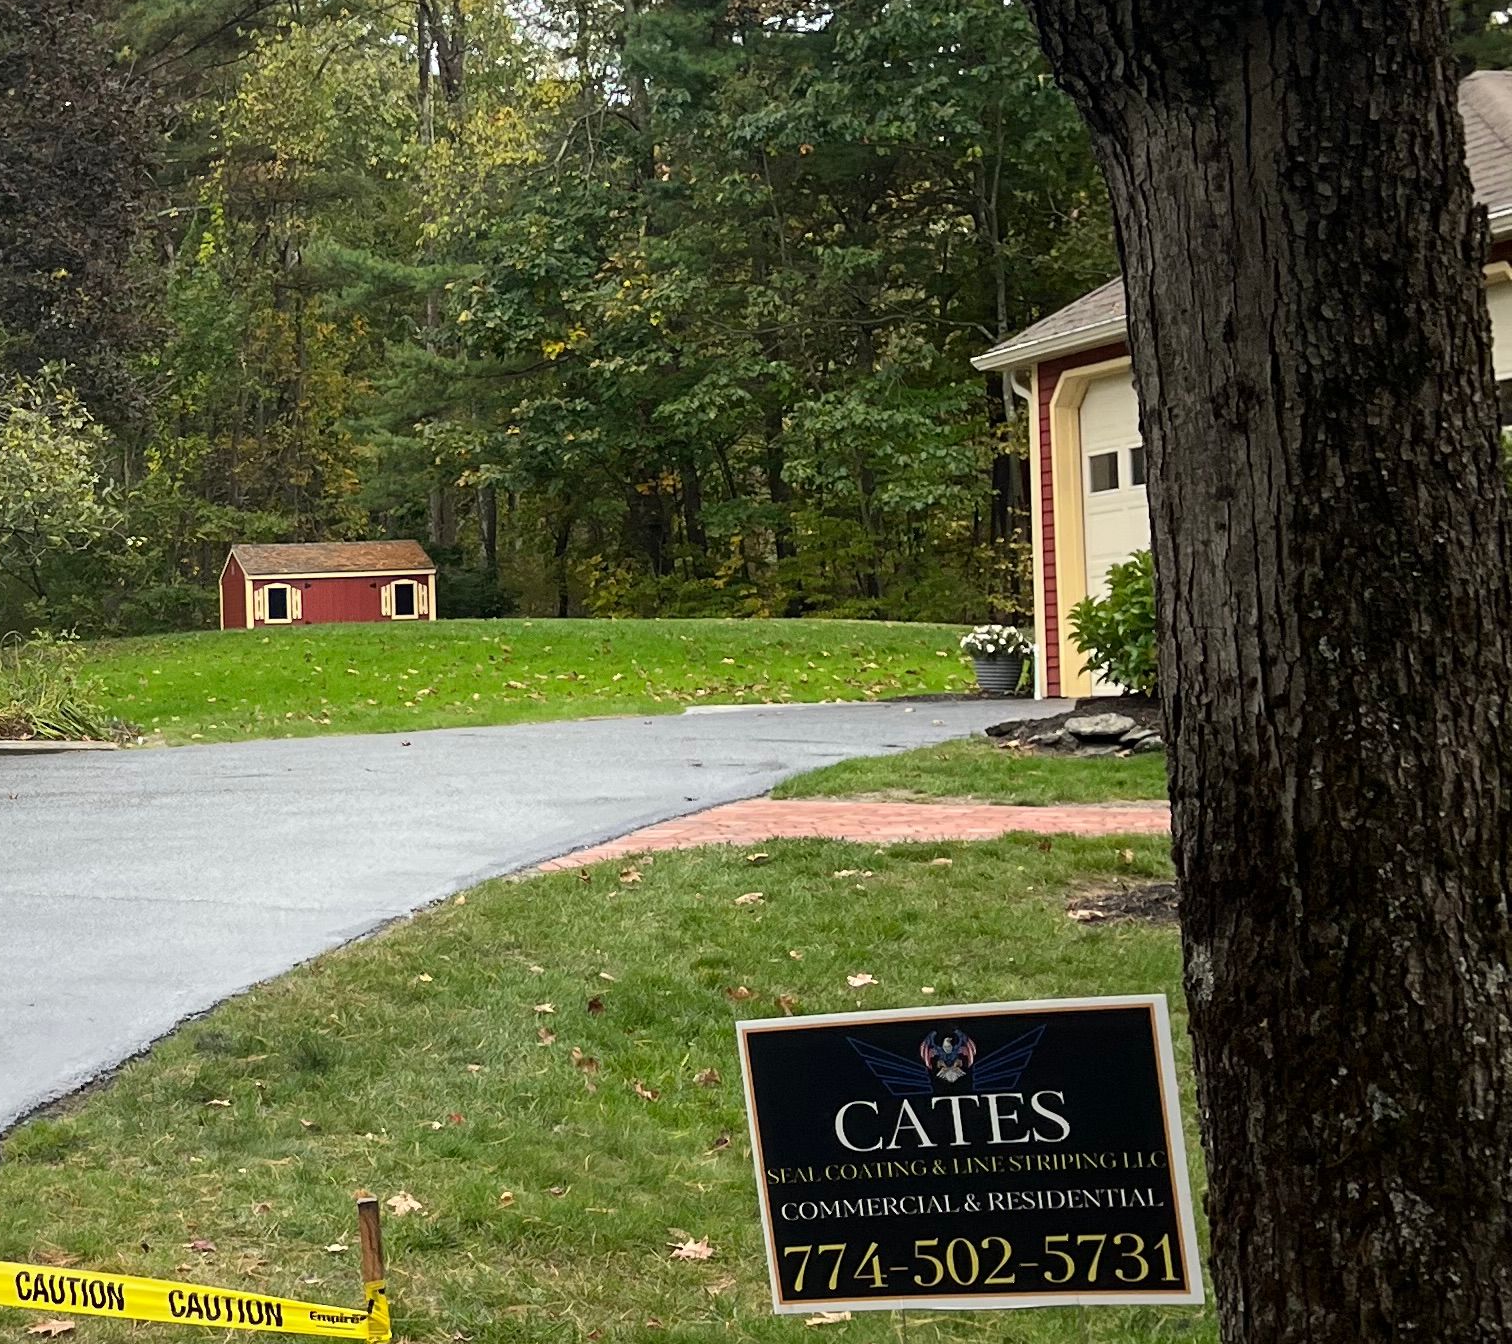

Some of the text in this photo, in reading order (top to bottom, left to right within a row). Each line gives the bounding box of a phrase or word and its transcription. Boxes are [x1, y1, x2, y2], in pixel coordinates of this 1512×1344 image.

[834, 1090, 1071, 1152] CATES
[767, 1150, 1167, 1185] SEAL COATING & LINE STRIPING LLC
[781, 1187, 1164, 1222] COMMERCIAL & RESIDENTIAL
[784, 1233, 1180, 1292] 774-502-5731
[15, 1271, 125, 1311] CAUTION
[168, 1289, 283, 1327] CAUTION
